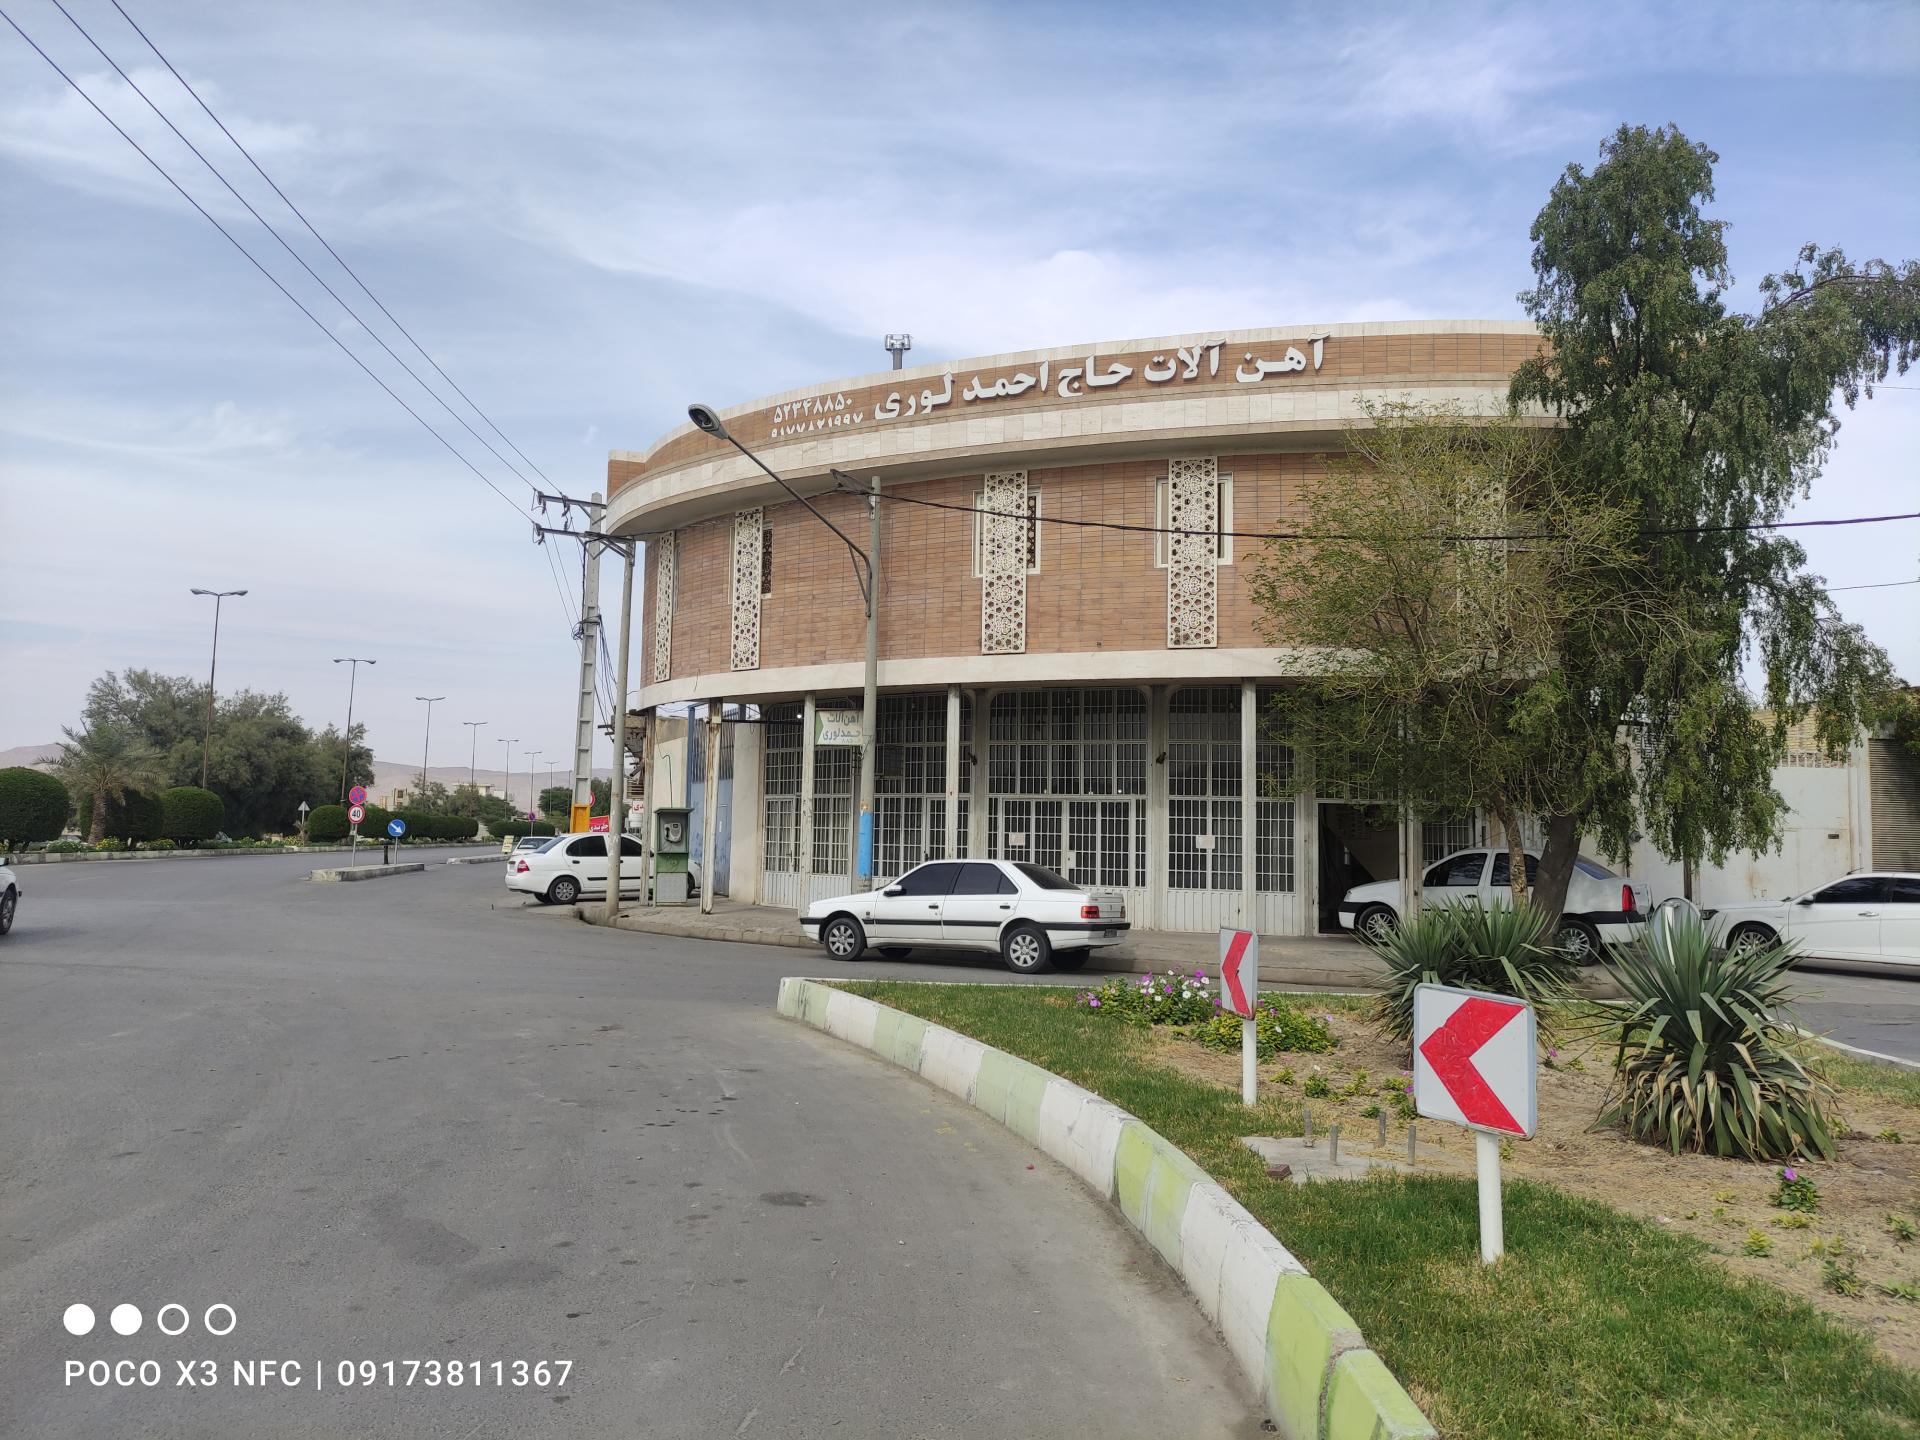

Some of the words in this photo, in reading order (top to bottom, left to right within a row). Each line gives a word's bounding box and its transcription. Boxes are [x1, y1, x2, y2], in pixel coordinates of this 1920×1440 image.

[1057, 354, 1134, 398] حاج
[1144, 338, 1227, 383] آلات
[1235, 331, 1331, 383] آهن
[874, 368, 954, 420] لوری
[962, 360, 1049, 402] احمد
[352, 810, 361, 818] 40
